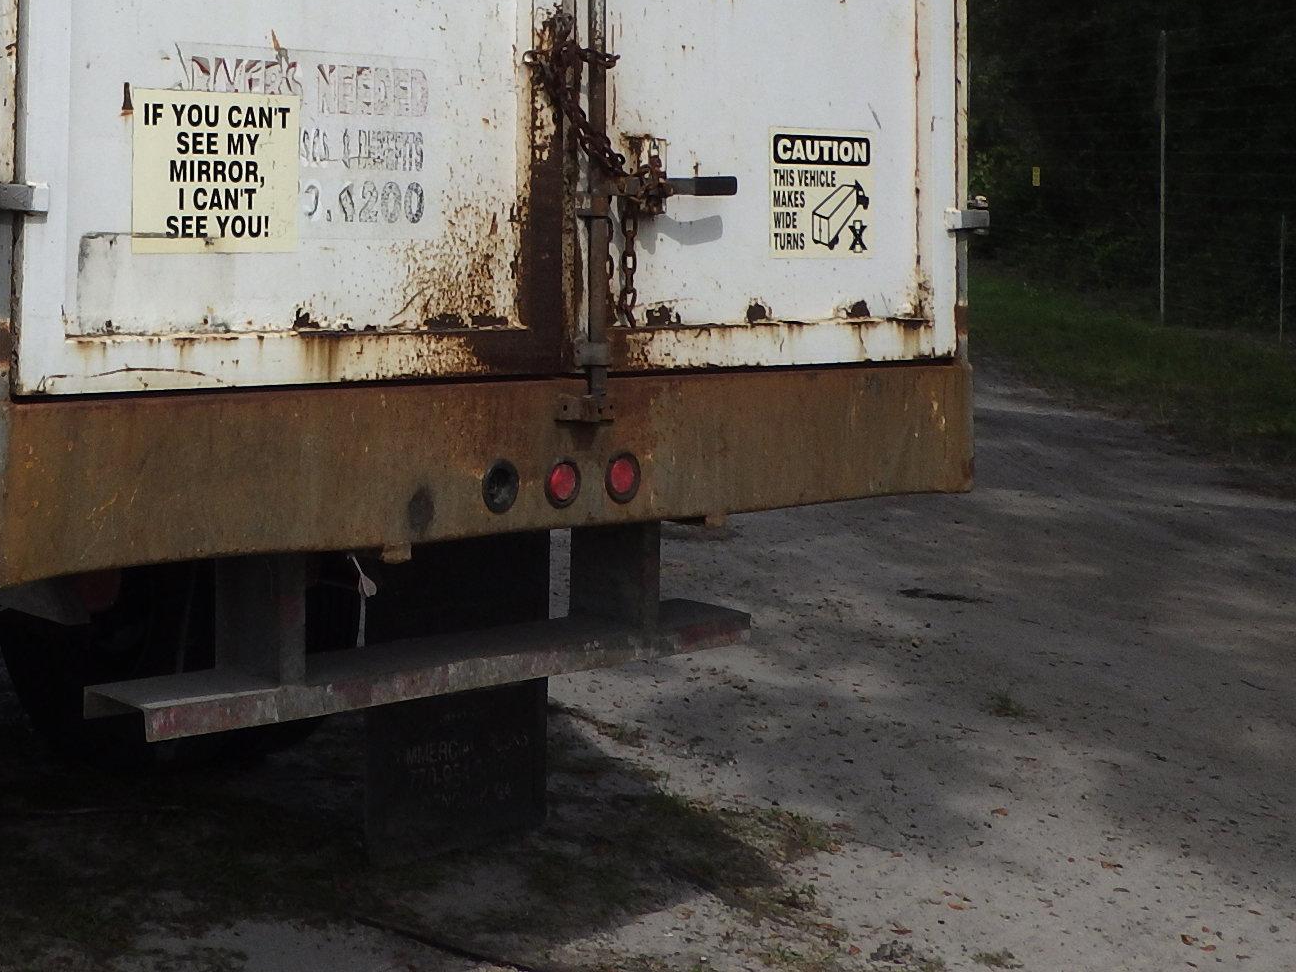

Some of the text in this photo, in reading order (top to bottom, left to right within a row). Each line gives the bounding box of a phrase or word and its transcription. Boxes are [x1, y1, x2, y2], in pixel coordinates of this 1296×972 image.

[144, 103, 291, 129] IF YOU CAN'T
[176, 132, 260, 156] SEE MY
[777, 138, 867, 163] CAUTION
[169, 160, 265, 188] MIRROR,
[773, 169, 836, 188] THIS VEHICLE
[178, 188, 257, 211] I CAN'T
[773, 190, 806, 208] MAKES
[166, 216, 270, 239] SEE YOU!
[773, 211, 798, 229] WIDE
[773, 232, 805, 250] TURNS
